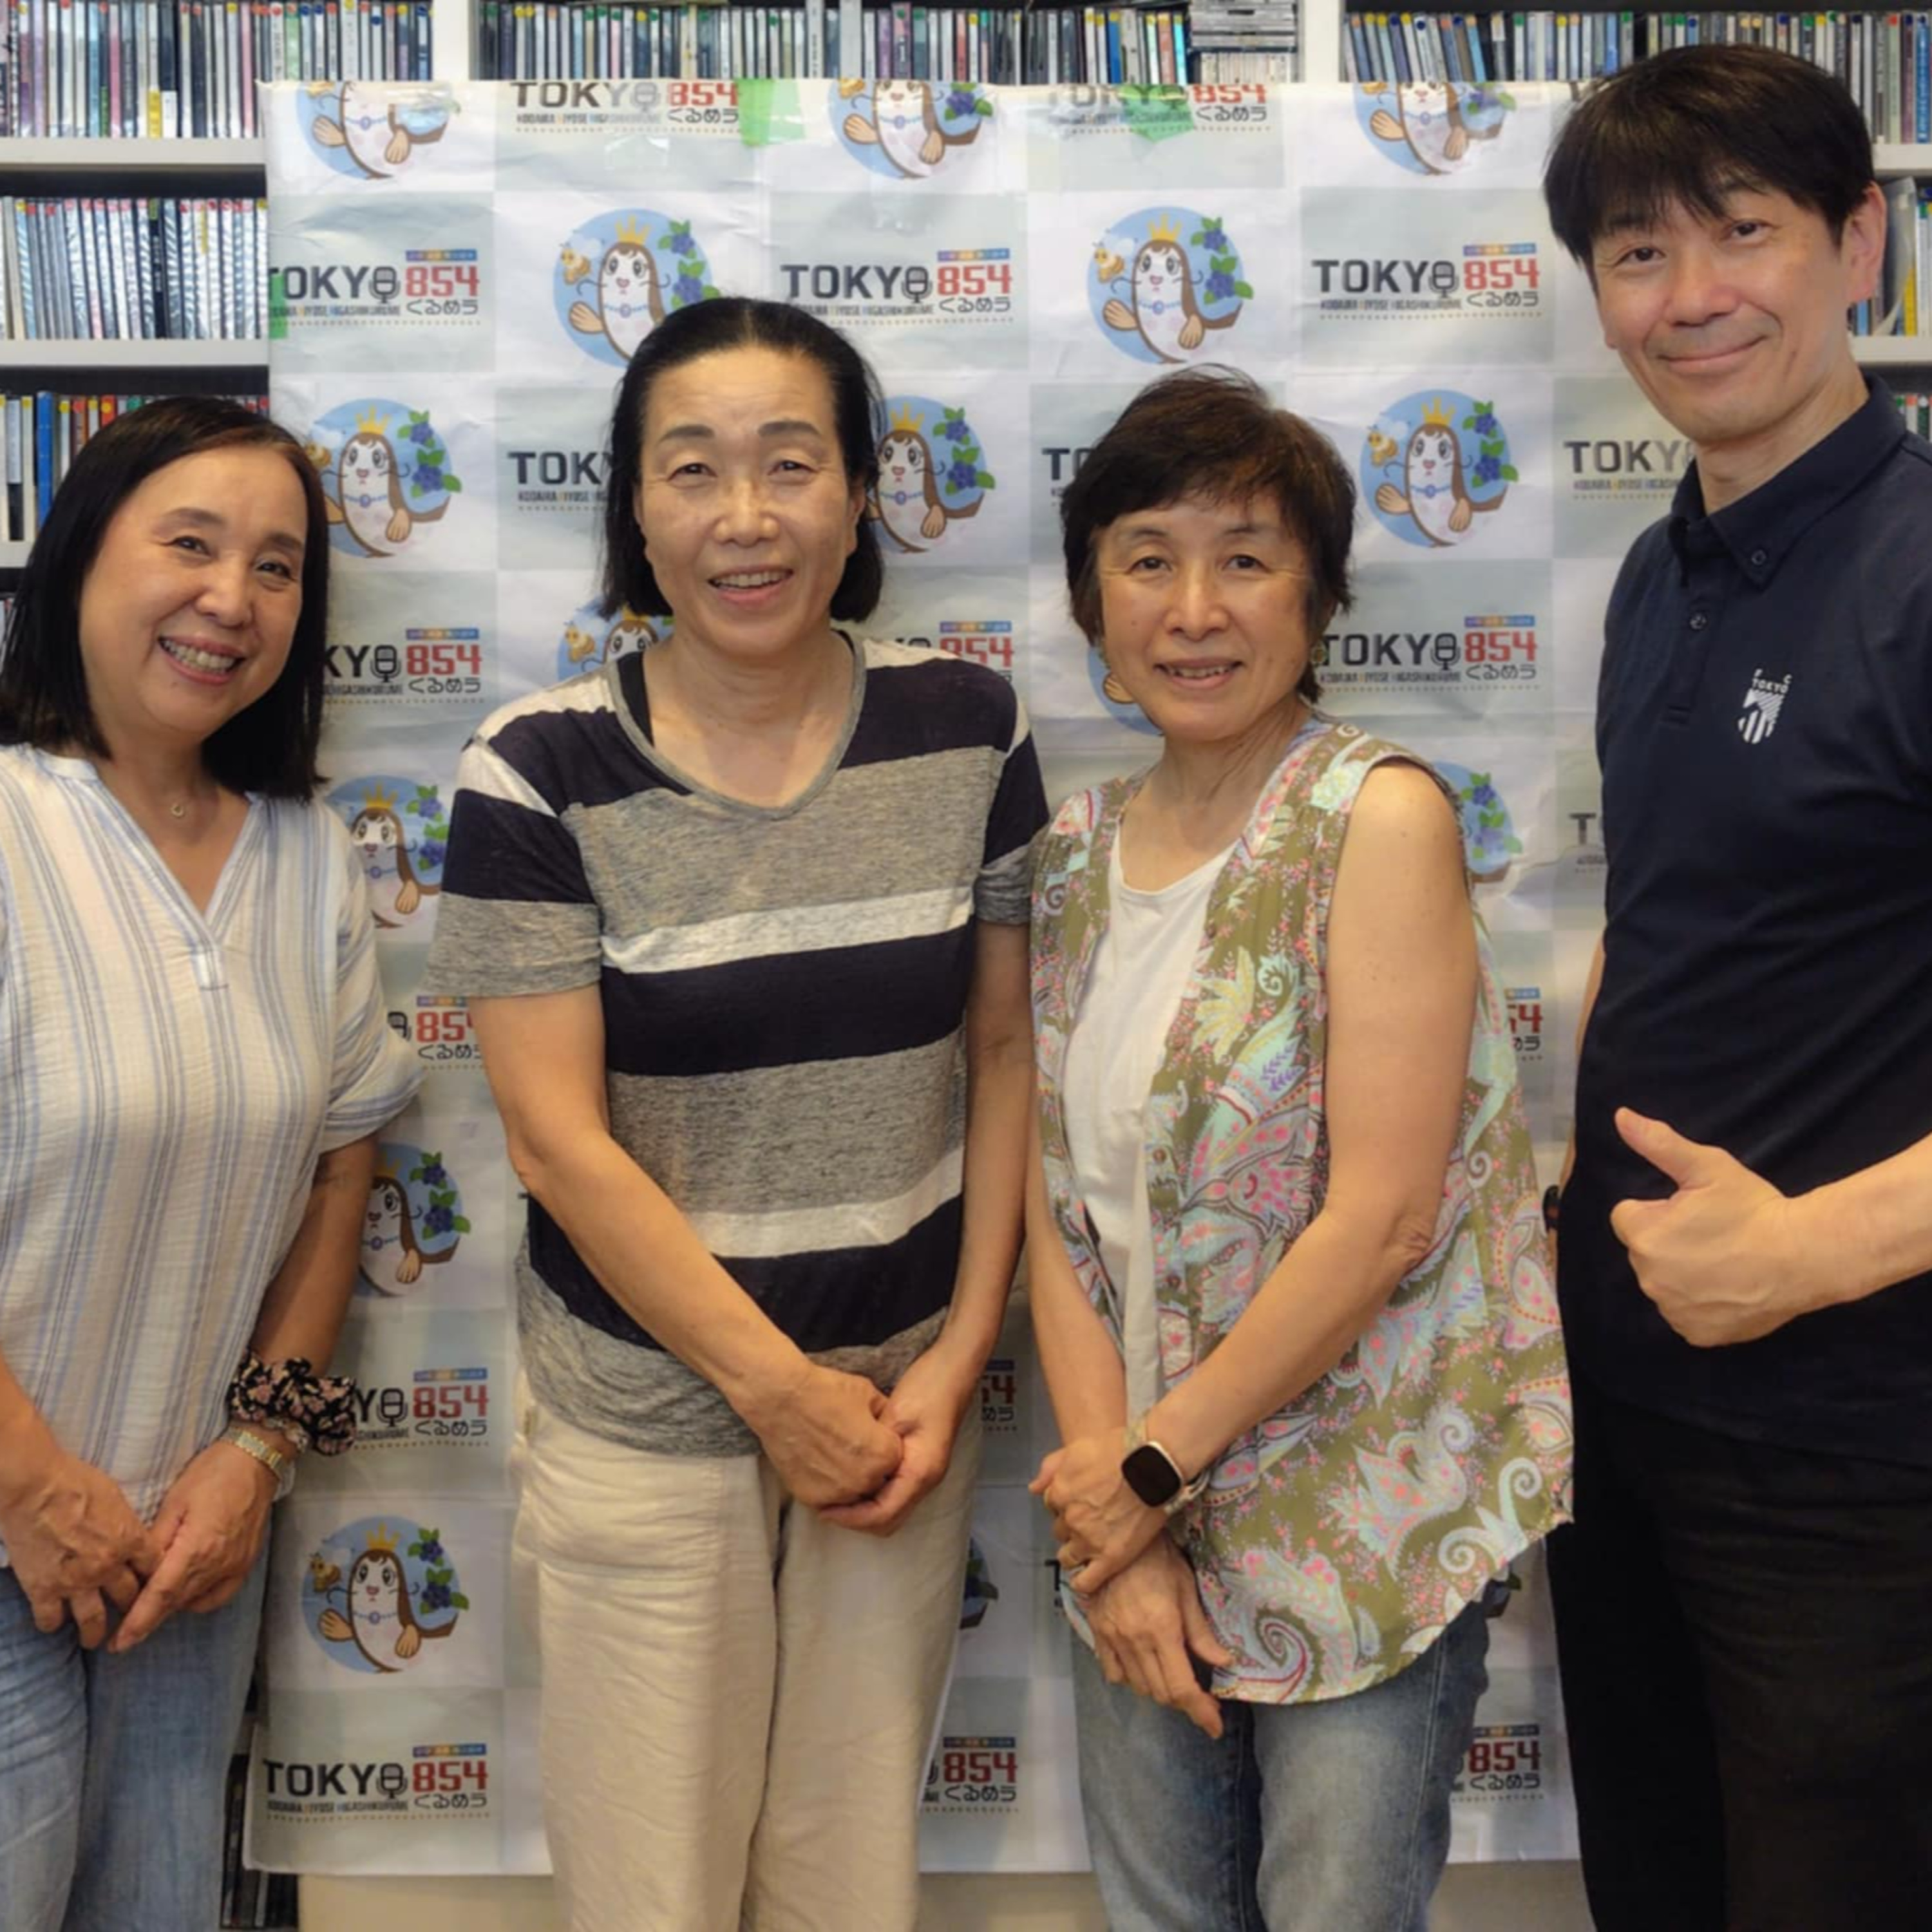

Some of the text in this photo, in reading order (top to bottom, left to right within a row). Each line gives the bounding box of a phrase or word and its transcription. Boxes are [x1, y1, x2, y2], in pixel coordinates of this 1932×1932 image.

[667, 82, 740, 106] 854
[1193, 84, 1267, 104] 854
[406, 265, 480, 297] 854
[780, 264, 1012, 303] TOKYO 854
[1311, 258, 1539, 299] TOKYO 854
[1564, 441, 1690, 473] TOKY
[406, 645, 482, 675] 854
[1464, 631, 1537, 662] 854
[416, 1012, 473, 1043] 85
[413, 1385, 489, 1419] 854
[944, 1752, 1018, 1783] 854
[1469, 1740, 1541, 1773] 854
[262, 1759, 488, 1799] TOKYO 854
